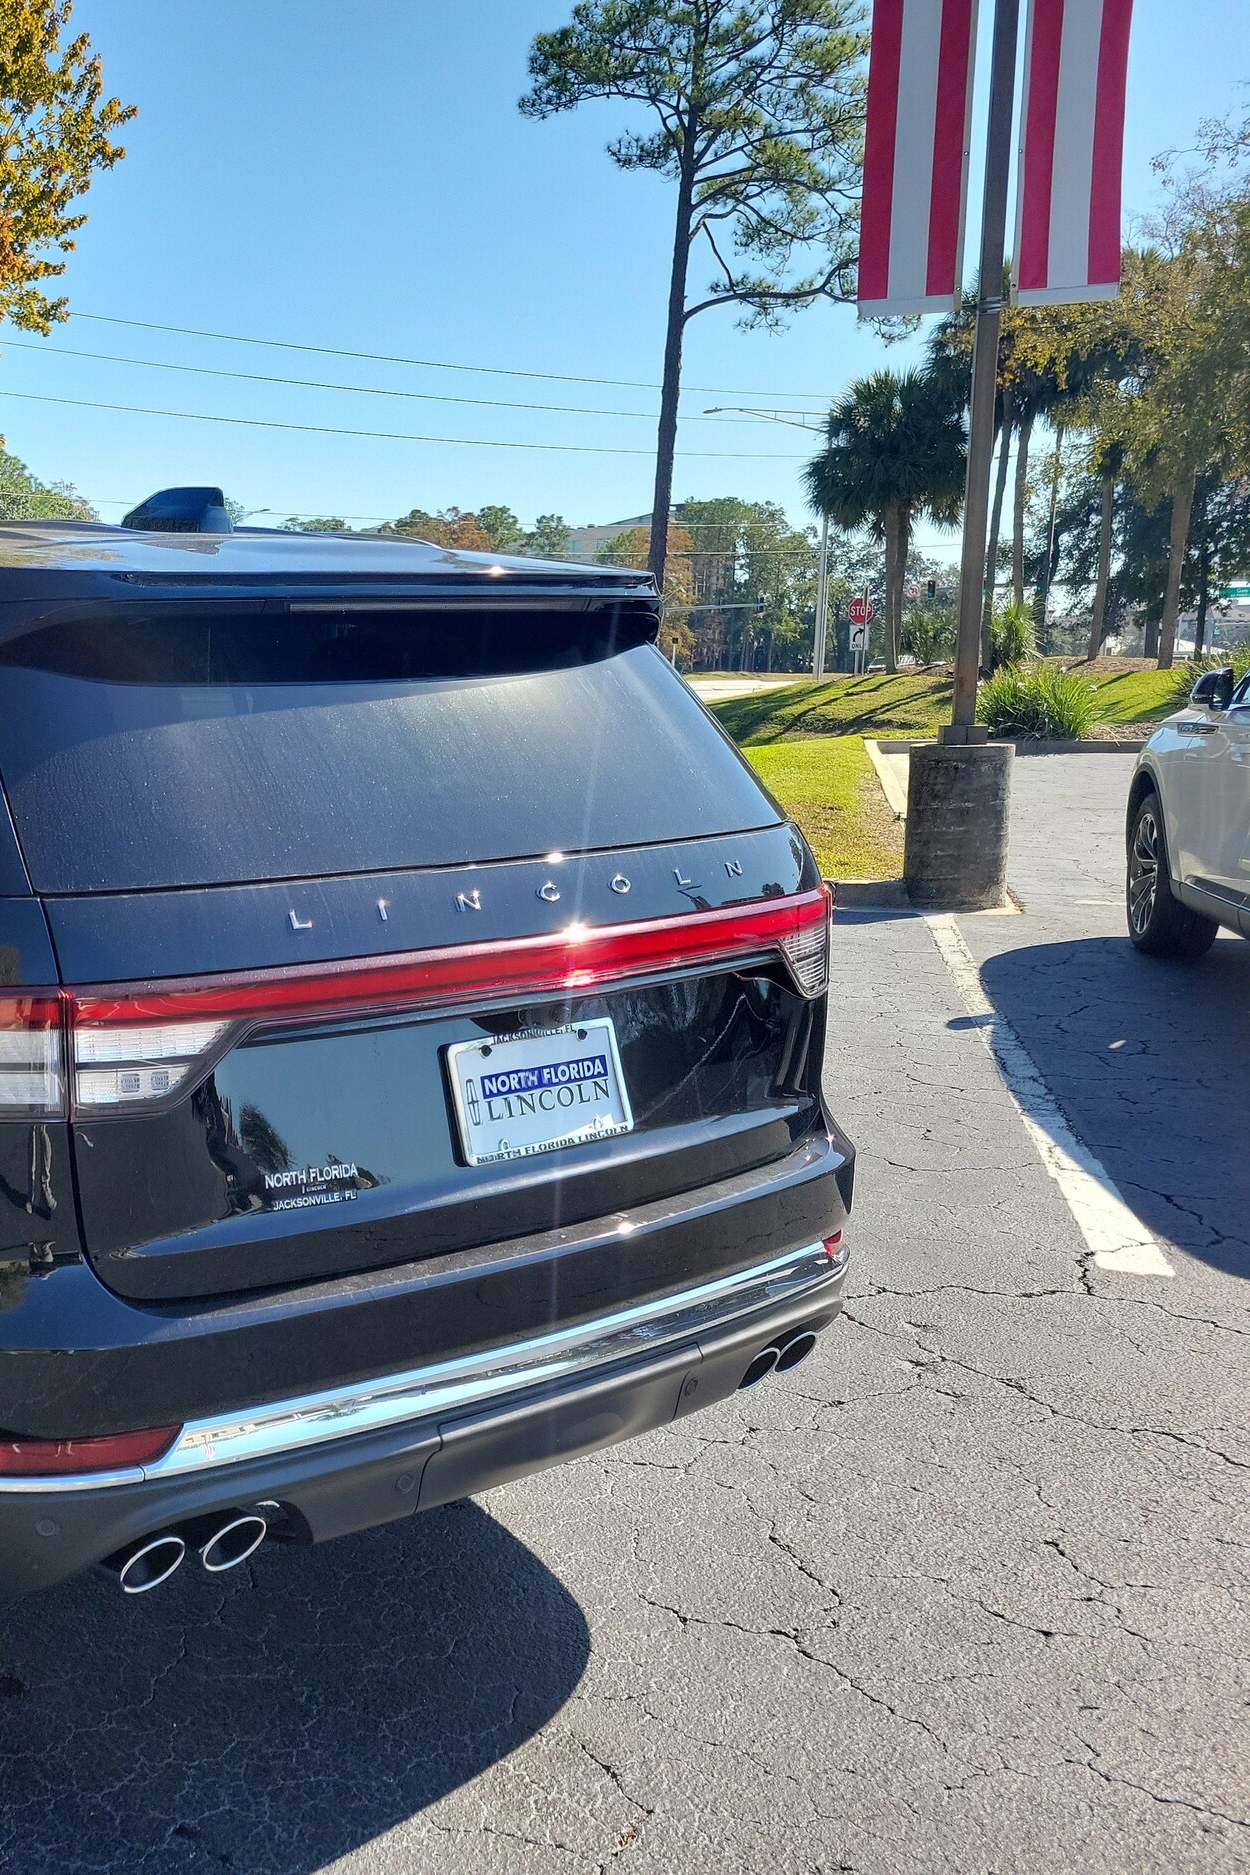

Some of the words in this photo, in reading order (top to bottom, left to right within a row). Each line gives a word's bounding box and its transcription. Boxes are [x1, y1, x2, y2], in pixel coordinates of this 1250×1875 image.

[850, 605, 871, 616] STOP
[289, 860, 745, 930] LINCOLN
[565, 1023, 577, 1034] FL
[483, 1069, 539, 1096] NORTH
[542, 1059, 605, 1085] FLORIDA
[485, 1078, 610, 1122] LINCOLN
[525, 1137, 575, 1155] FLORIDA
[578, 1124, 629, 1143] LINCOLN
[264, 1170, 307, 1190] NORTH
[310, 1162, 359, 1182] FLORIDA
[345, 1188, 357, 1201] FL
